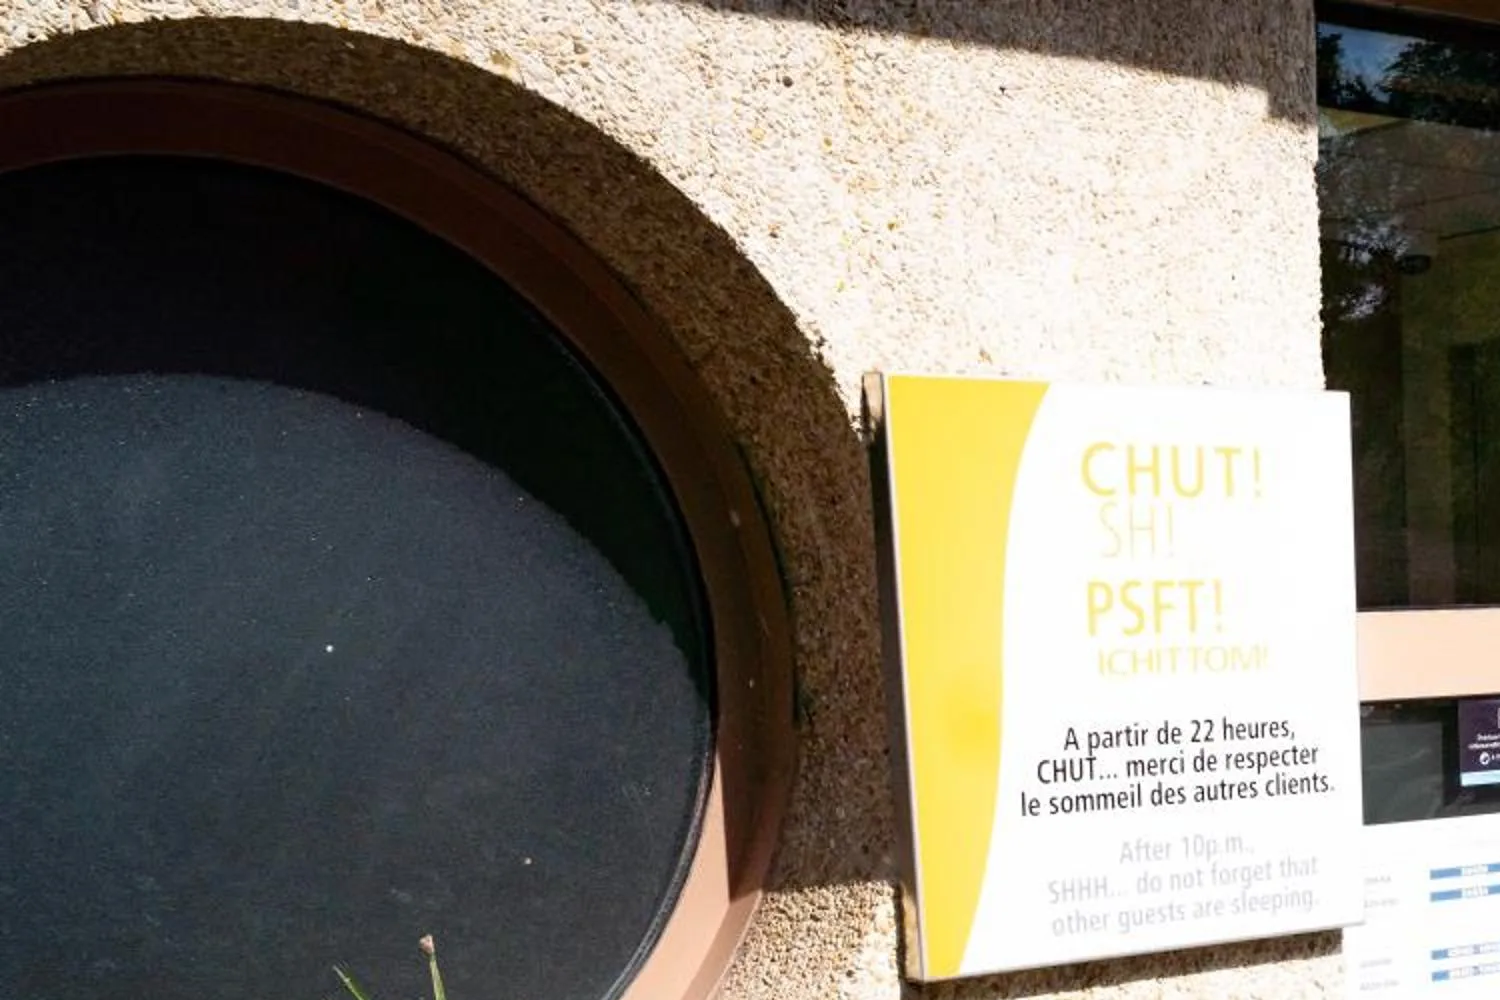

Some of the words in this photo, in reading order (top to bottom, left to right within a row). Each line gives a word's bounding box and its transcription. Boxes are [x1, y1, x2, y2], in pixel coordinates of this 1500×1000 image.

[1081, 441, 1262, 499] CHUT!
[1099, 501, 1175, 559] SH!
[1087, 579, 1224, 638] PSFT!
[1064, 727, 1080, 751] A
[1087, 722, 1149, 755] partir
[1157, 720, 1183, 745] de
[1191, 719, 1215, 743] 22
[1223, 717, 1296, 742] heures,
[1037, 757, 1118, 784] CHUT...
[1127, 751, 1185, 778] merci
[1193, 748, 1218, 773] de
[1225, 746, 1319, 775] respecter
[1021, 791, 1041, 817] le
[1049, 783, 1143, 815] sommeil
[1150, 781, 1187, 807] des
[1194, 778, 1259, 803] autres
[1265, 772, 1335, 797] clients.
[1119, 838, 1172, 864] After
[1048, 876, 1128, 905] SHHH...
[1136, 871, 1162, 896] do
[1170, 869, 1204, 892] not
[1211, 861, 1272, 890] forget
[1279, 854, 1319, 879] that
[1052, 909, 1110, 937] other
[1118, 902, 1186, 934] guests
[1192, 897, 1224, 920] are
[1231, 886, 1320, 916] sleeping.
